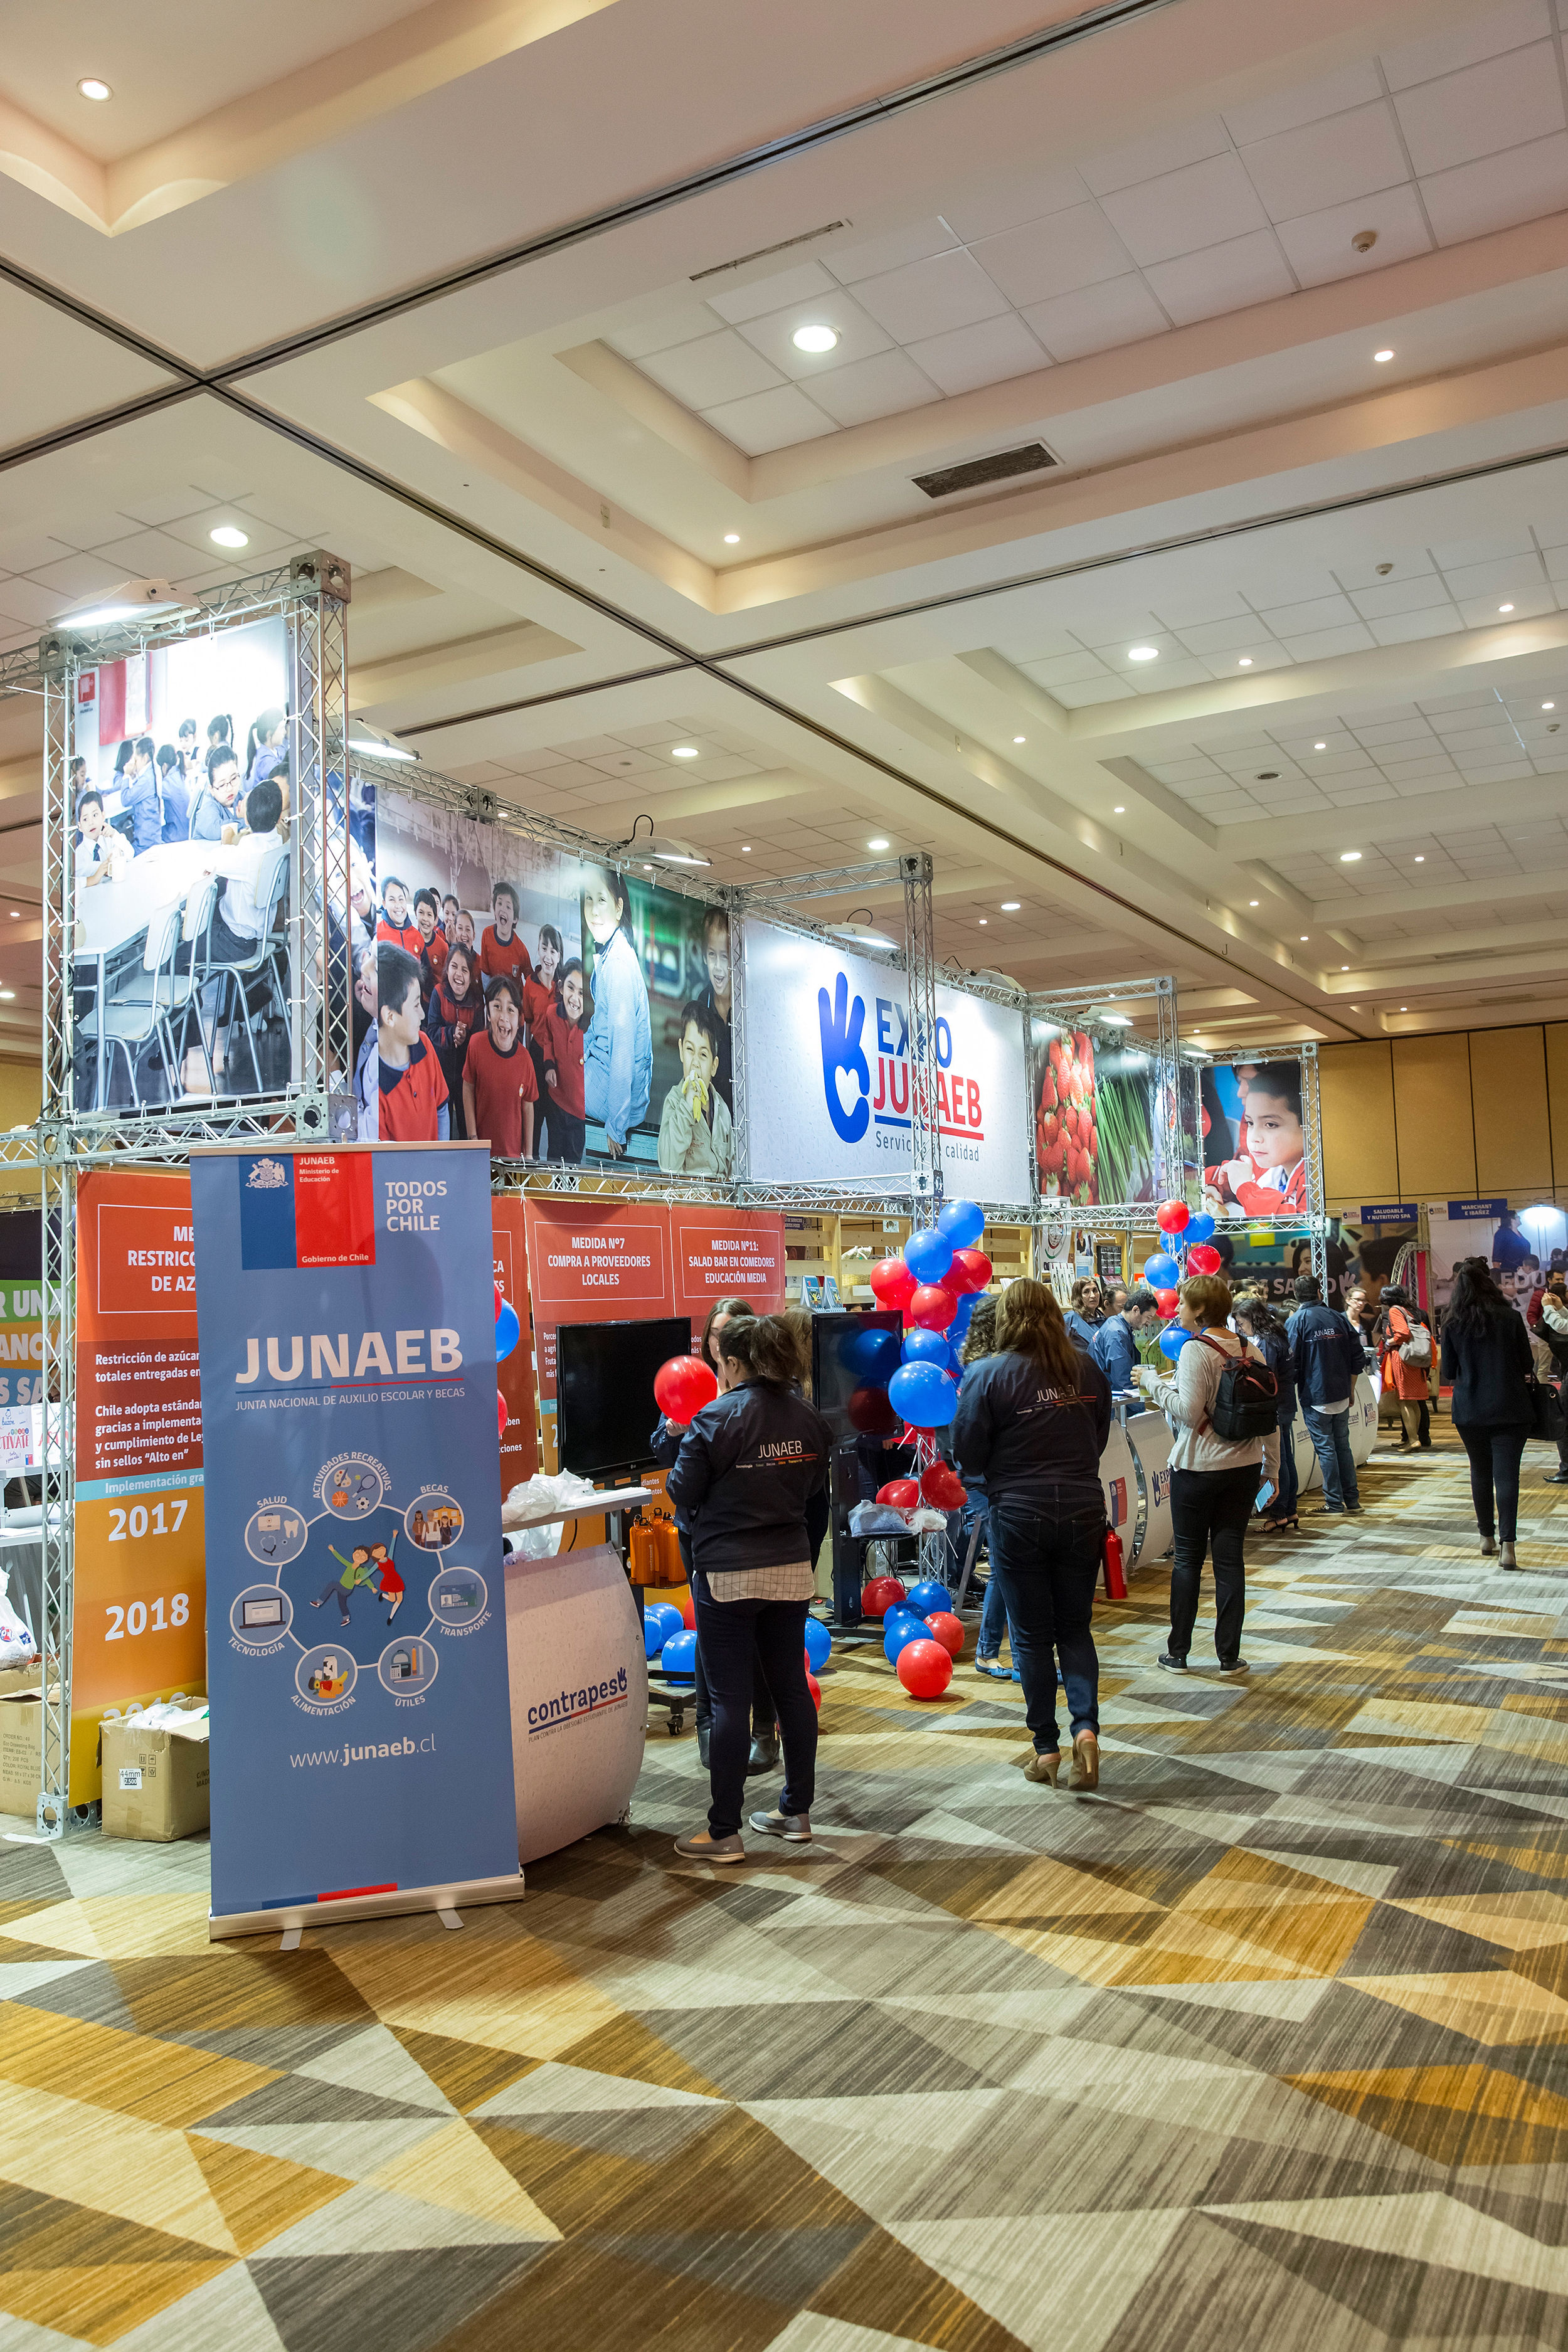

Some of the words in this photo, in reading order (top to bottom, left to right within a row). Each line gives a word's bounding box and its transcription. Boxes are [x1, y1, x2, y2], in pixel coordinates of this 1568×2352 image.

[873, 1057, 982, 1127] JUNAEB
[945, 1143, 979, 1162] calidad
[299, 1157, 336, 1165] JUNAEB
[385, 1180, 448, 1197] TODOS
[386, 1198, 424, 1215] POR
[386, 1215, 440, 1232] CHILE
[571, 1237, 607, 1249] MEDIDA
[711, 1240, 740, 1251] MEDIDA
[301, 1254, 337, 1263] Gobierno
[339, 1254, 347, 1262] de
[349, 1253, 369, 1261] Chile
[548, 1255, 582, 1267] COMPRA
[584, 1256, 590, 1267] A
[591, 1256, 651, 1267] PROVEEDORES
[689, 1256, 712, 1267] SALAD
[714, 1256, 728, 1267] BAR
[729, 1257, 739, 1267] EN
[740, 1257, 775, 1268] COMEDORES
[151, 1276, 172, 1291] DE
[175, 1276, 196, 1291] AZ
[582, 1274, 620, 1285] LOCALES
[705, 1271, 746, 1283] EDUCACIÓN
[747, 1273, 766, 1283] MEDIA
[1313, 1328, 1335, 1337] JUNAEB
[95, 1352, 152, 1365] Restricción
[154, 1352, 167, 1363] de
[235, 1328, 463, 1384] JUNAEB
[95, 1370, 132, 1382] totales
[134, 1369, 188, 1382] entregadas
[546, 1370, 554, 1378] más
[235, 1399, 267, 1411] JUNTA
[269, 1397, 321, 1409] NACIONAL
[323, 1395, 337, 1405] DE
[339, 1392, 378, 1404] AUXILIO
[381, 1390, 425, 1402] ESCOLAR
[426, 1390, 433, 1399] Y
[435, 1387, 465, 1399] BECAS
[95, 1404, 122, 1417] Chile
[125, 1403, 159, 1417] adopta
[95, 1421, 132, 1437] gracias
[134, 1422, 140, 1431] a
[142, 1416, 203, 1433] implementa
[0, 1433, 29, 1449] TÍVATE
[95, 1443, 102, 1454] y
[104, 1435, 175, 1453] cumplimiento
[177, 1433, 188, 1443] de
[758, 1440, 802, 1458] JUNAEB
[95, 1457, 111, 1469] sin
[114, 1454, 142, 1467] sellos
[313, 1452, 349, 1498] ACTIVIDADES
[351, 1451, 392, 1491] RECREATIVAS
[105, 1473, 187, 1494] Implementación
[189, 1473, 204, 1486] gra
[420, 1484, 449, 1493] BECAS
[257, 1495, 287, 1508] SALUD
[108, 1500, 188, 1542] 2017
[105, 1593, 189, 1641] 2018
[440, 1610, 492, 1637] TRANSPORTE
[228, 1636, 285, 1656] TECNOLOGÍA
[290, 1694, 356, 1716] ALIMENTACIÓN
[395, 1695, 426, 1707] ÚTILES
[529, 1734, 539, 1743] PLAN
[540, 1728, 556, 1739] CONTRA
[563, 1718, 583, 1730] OBESIDAD
[583, 1708, 607, 1722] ESTUDIANTIL
[290, 1733, 437, 1768] www.junaeb.cl
